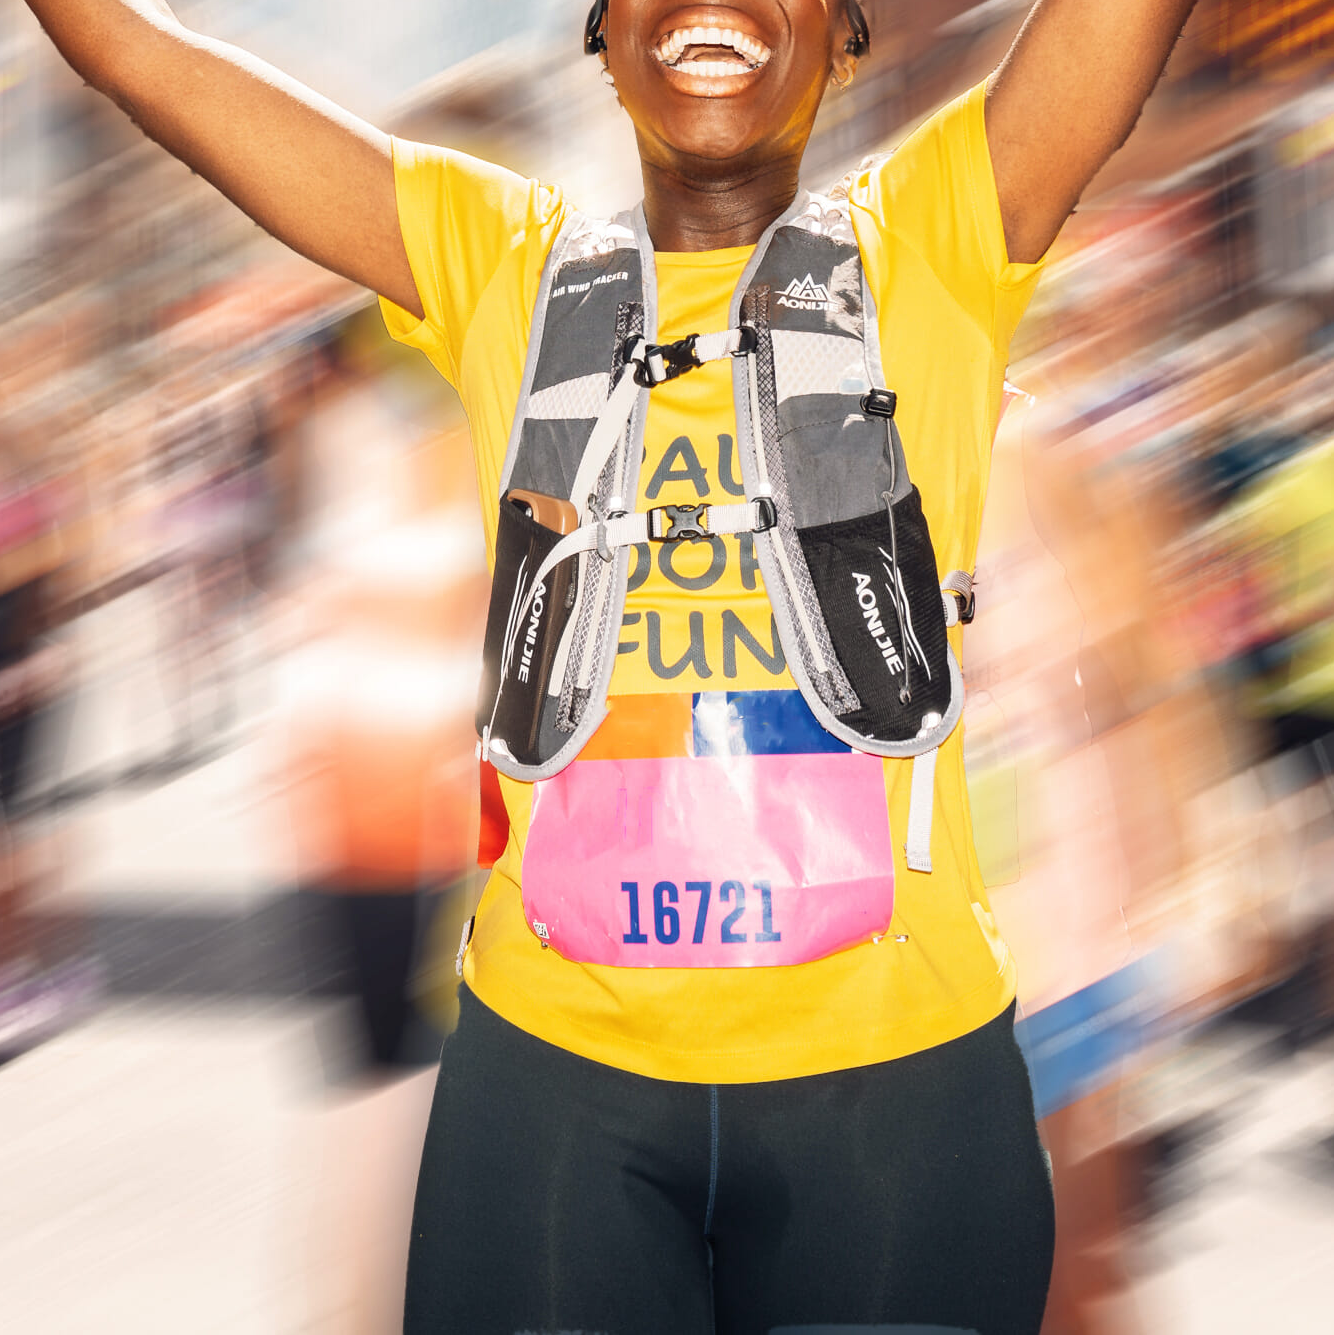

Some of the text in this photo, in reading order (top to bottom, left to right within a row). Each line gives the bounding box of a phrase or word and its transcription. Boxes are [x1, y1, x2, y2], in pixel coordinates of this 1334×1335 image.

[553, 286, 566, 298] AIR
[568, 282, 591, 294] WIND
[776, 295, 839, 312] AONIJIE
[517, 581, 547, 683] AONIJIE
[851, 572, 905, 676] AONIJIE
[621, 880, 781, 944] 16721
